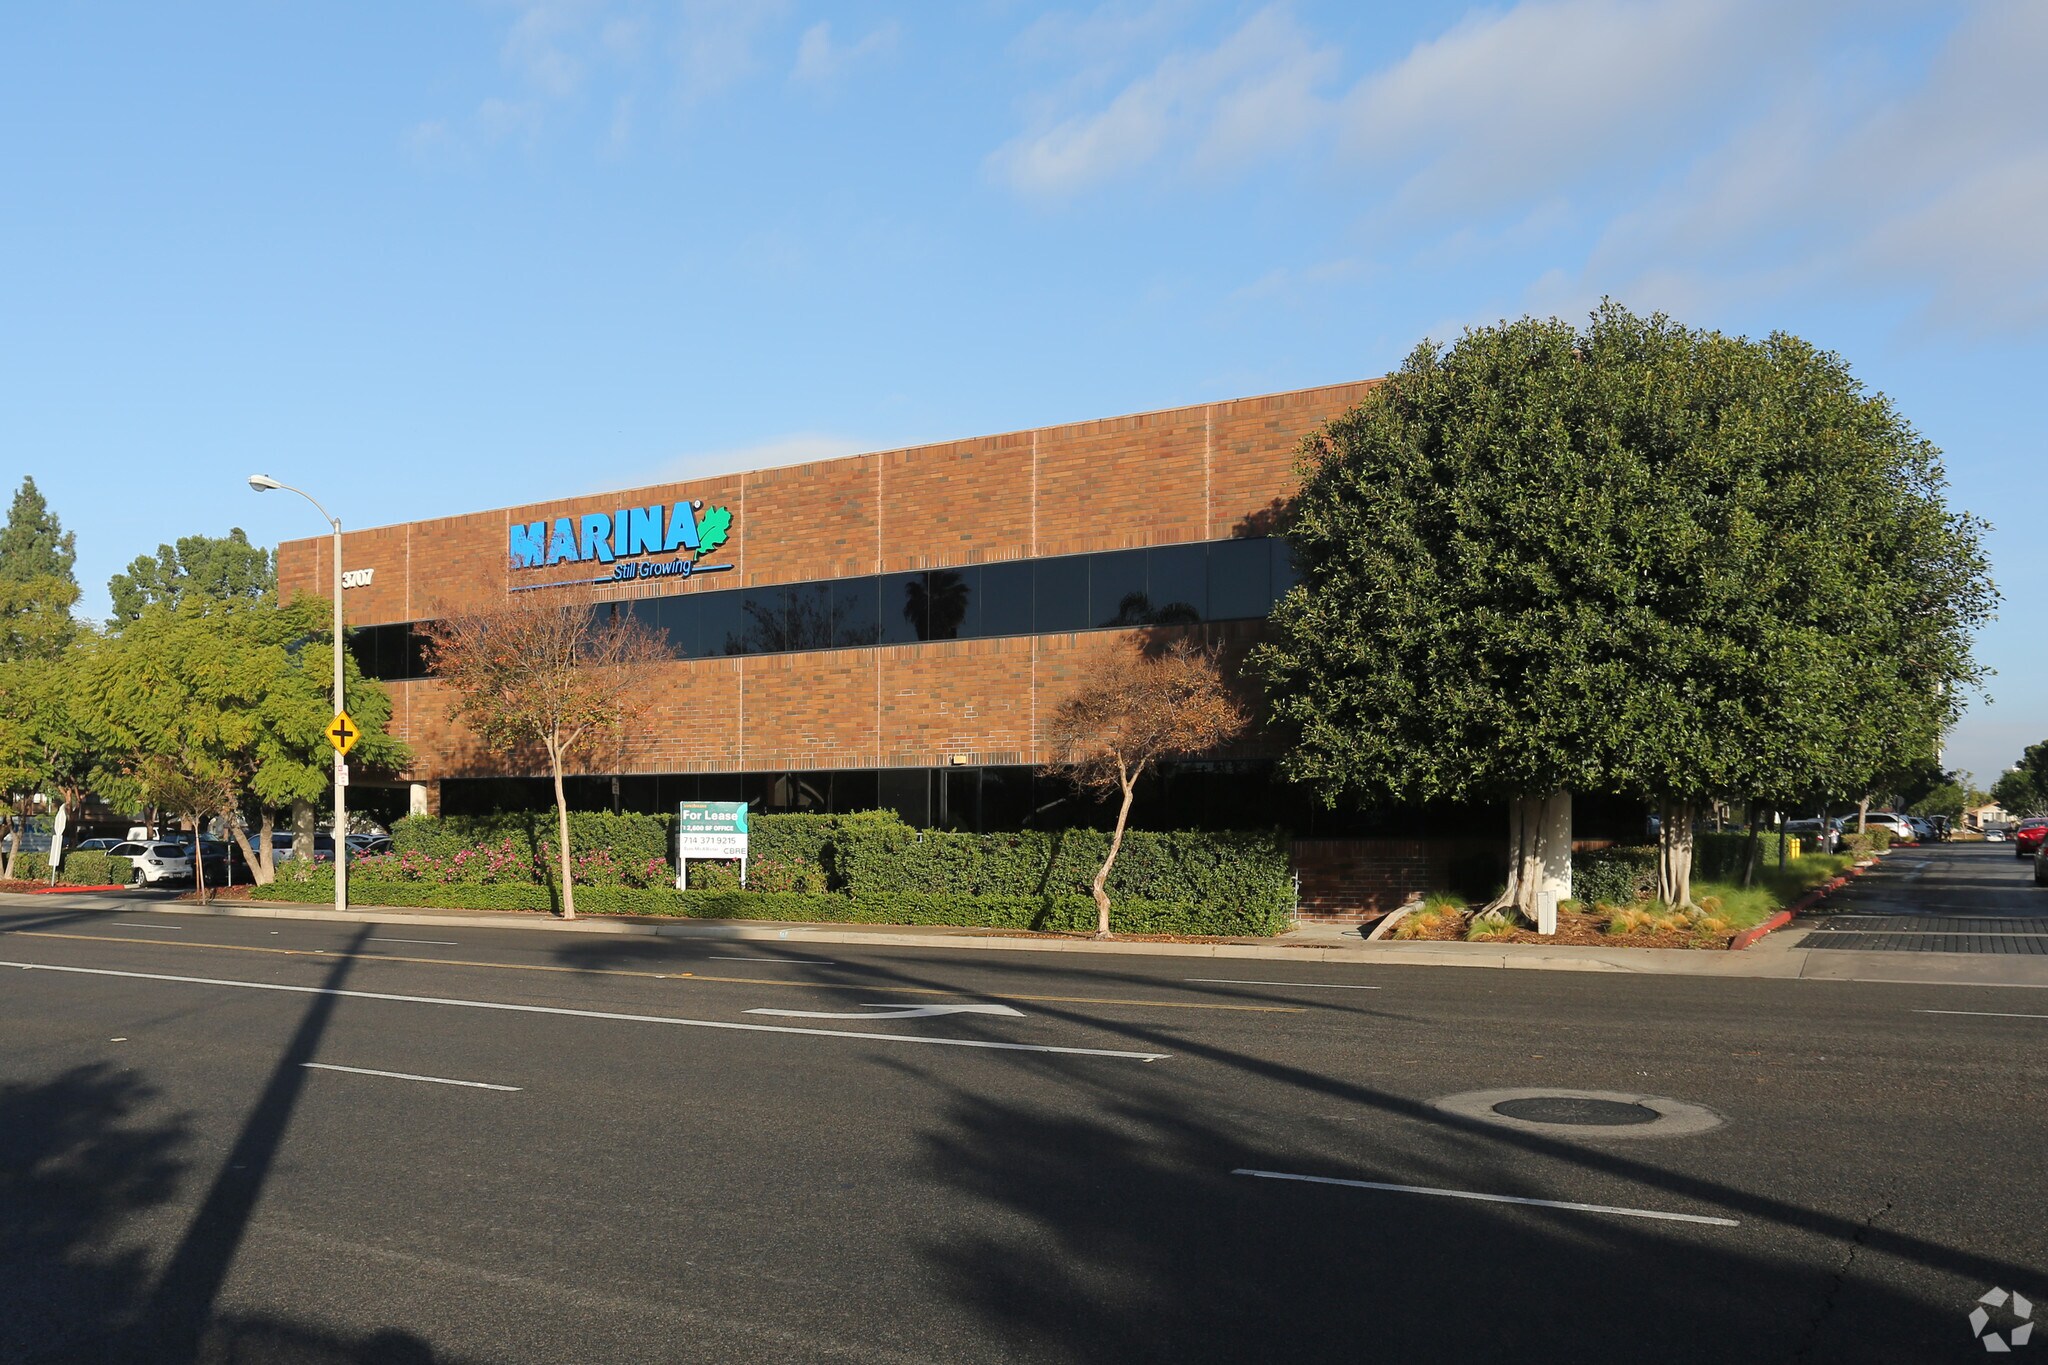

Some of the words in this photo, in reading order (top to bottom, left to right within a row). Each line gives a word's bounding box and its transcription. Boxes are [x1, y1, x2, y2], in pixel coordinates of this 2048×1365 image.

[510, 501, 700, 569] MARINA
[342, 568, 375, 588] 3707
[614, 562, 637, 580] Still
[640, 559, 692, 577] Growing
[683, 810, 702, 820] For
[704, 810, 738, 820] Lease
